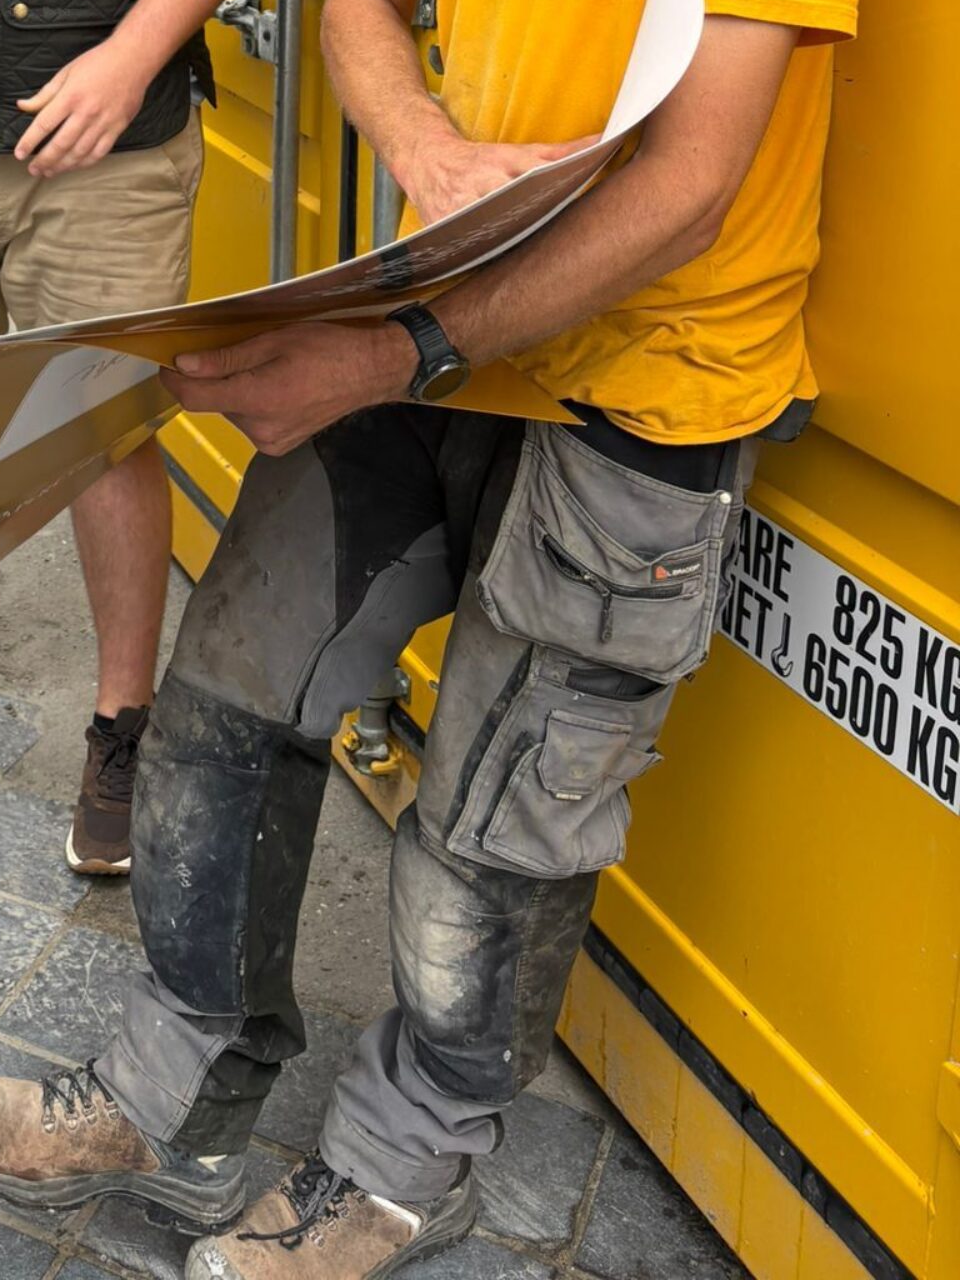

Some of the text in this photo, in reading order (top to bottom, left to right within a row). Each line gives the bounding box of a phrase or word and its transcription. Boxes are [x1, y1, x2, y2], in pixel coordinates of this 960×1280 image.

[803, 632, 898, 757] 6500
[907, 704, 960, 806] KG
[833, 574, 906, 681] 825
[914, 625, 960, 726] KG
